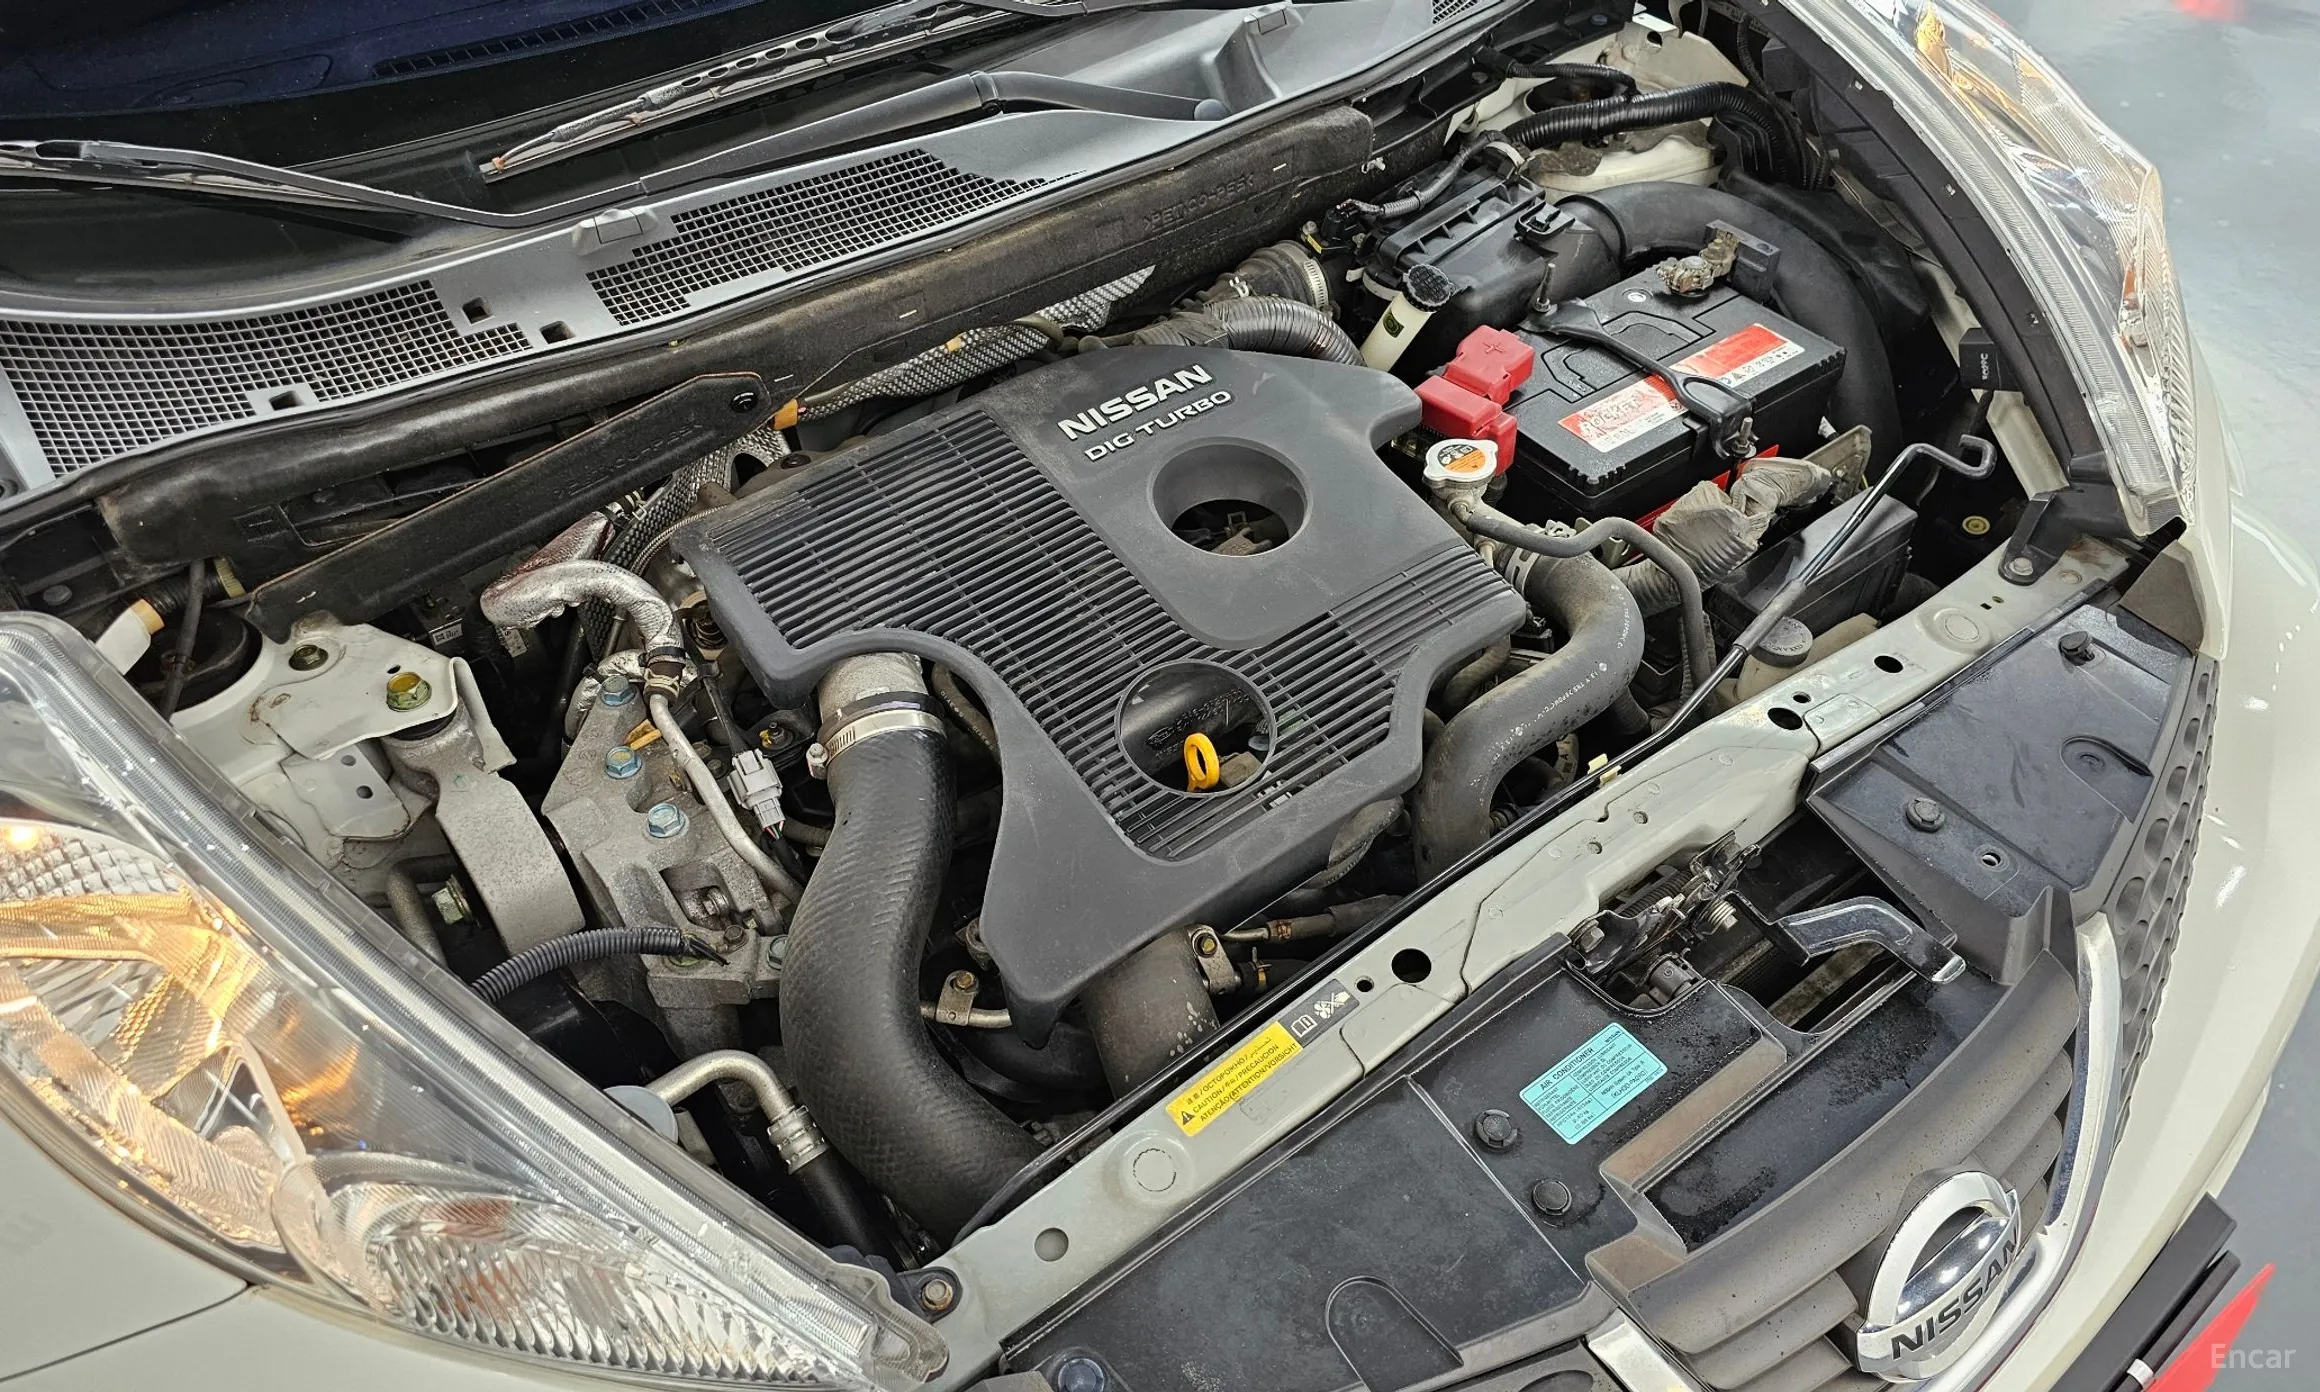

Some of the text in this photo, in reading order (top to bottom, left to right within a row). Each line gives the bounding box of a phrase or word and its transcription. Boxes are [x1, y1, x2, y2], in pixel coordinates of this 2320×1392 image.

[1057, 364, 1213, 440] NISSAN
[1539, 1047, 1594, 1089] AIR CONDITIONER
[1892, 1227, 2019, 1360] NISSAN
